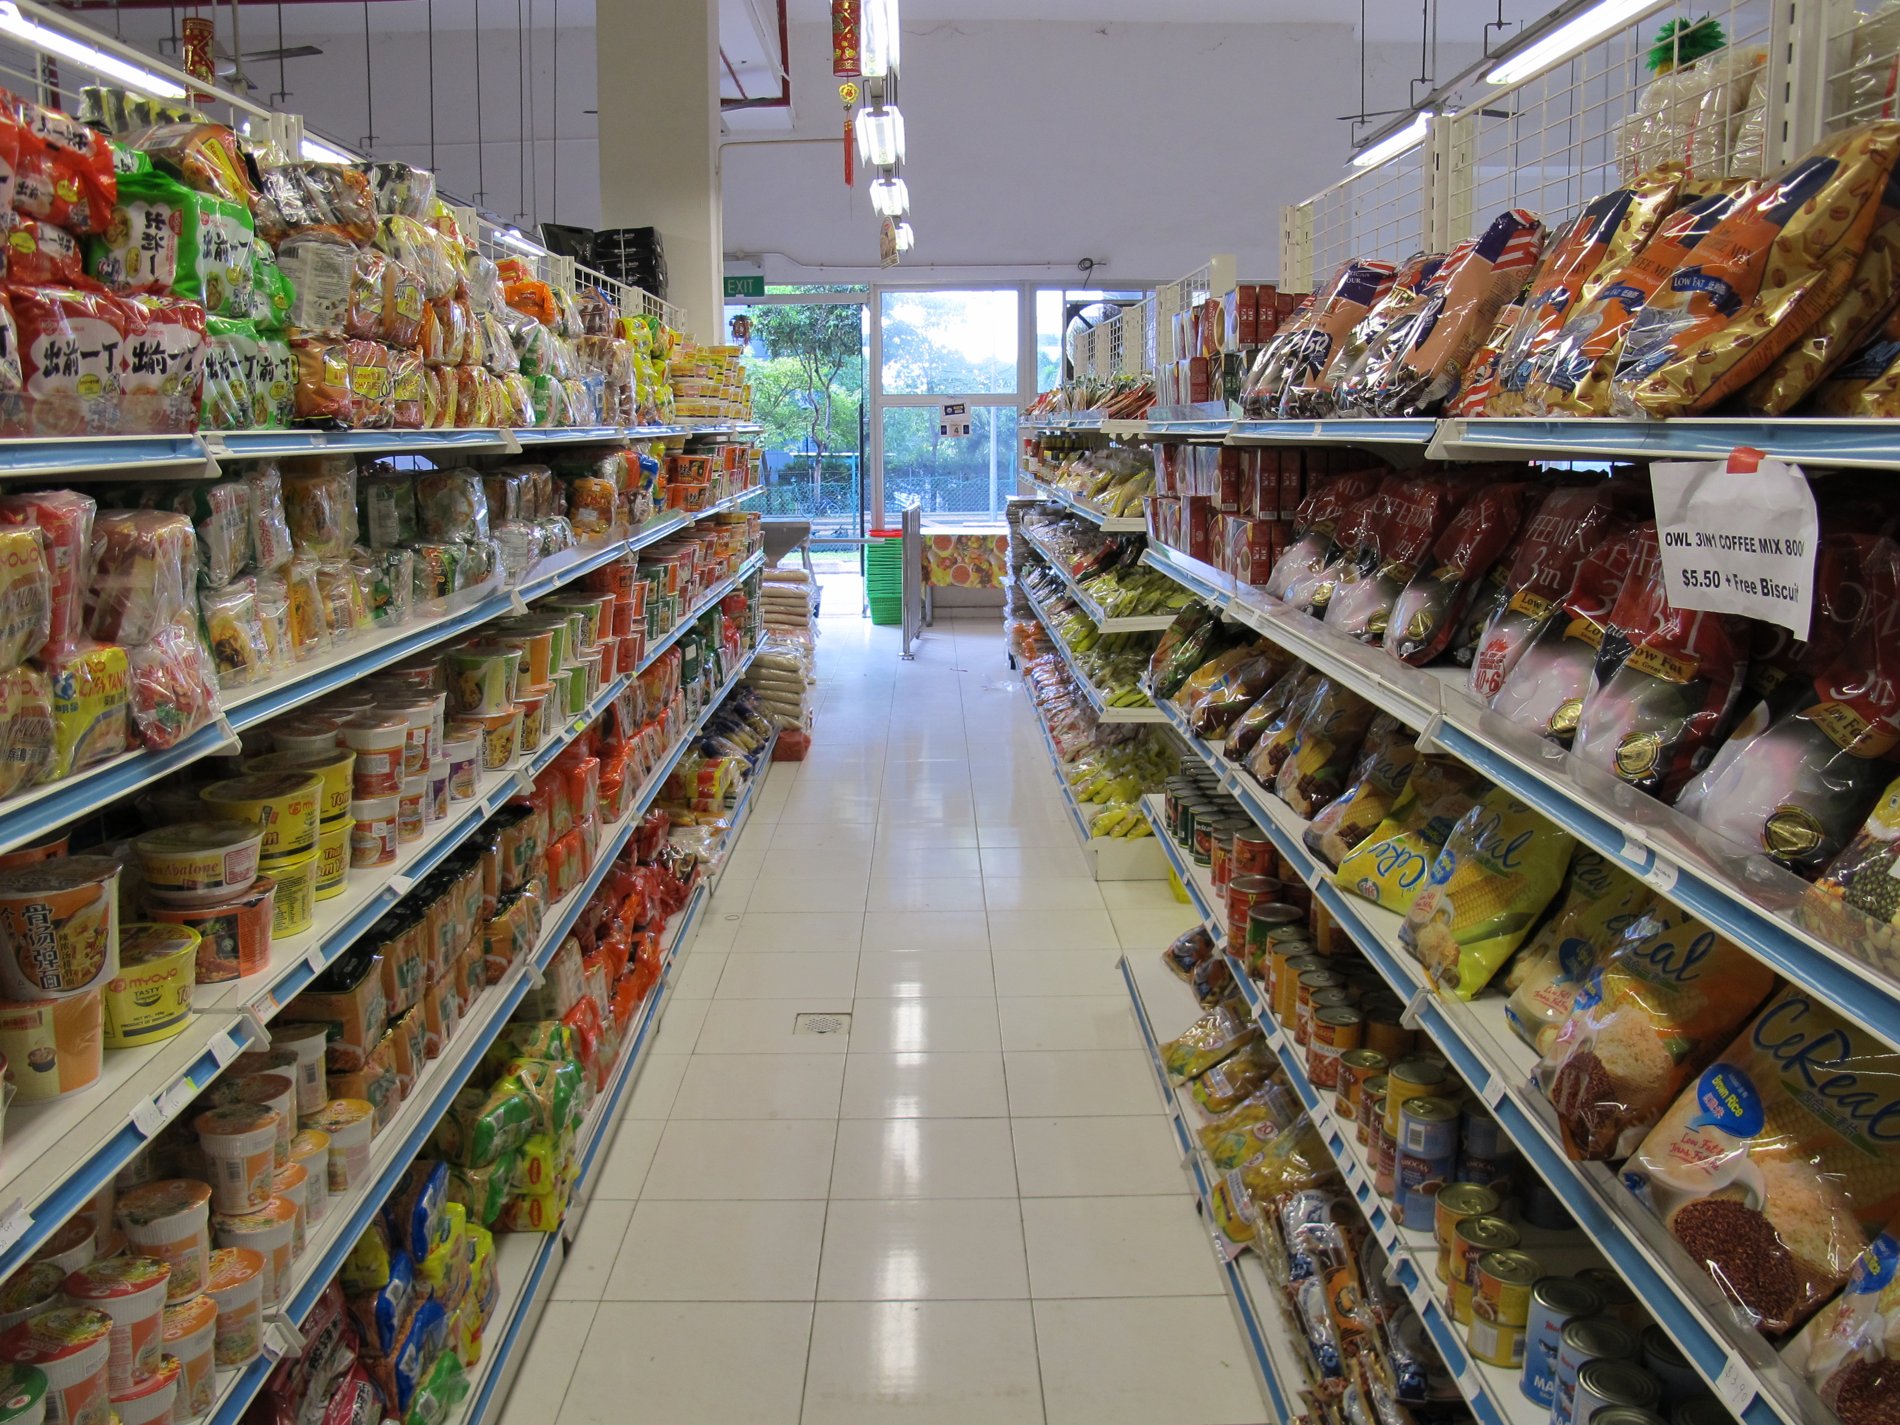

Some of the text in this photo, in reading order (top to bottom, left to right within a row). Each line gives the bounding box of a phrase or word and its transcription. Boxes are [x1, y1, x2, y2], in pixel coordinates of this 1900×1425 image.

[727, 279, 754, 294] EXIT
[1674, 277, 1705, 288] LOW FAT
[43, 338, 119, 379] 出前一丁
[1665, 532, 1692, 547] OWL
[1695, 532, 1717, 548] 3IN1
[1719, 535, 1757, 553] COFFEE
[1759, 538, 1783, 555] MIX
[1682, 568, 1721, 589] $5.50
[1725, 575, 1731, 587] +
[1733, 573, 1758, 595] Free
[1520, 593, 1545, 609] Low
[1659, 653, 1685, 676] Fat
[134, 985, 160, 997] TASTY
[1711, 1073, 1729, 1099] Brown
[1725, 1094, 1744, 1118] Rice
[1533, 1375, 1555, 1393] MA
